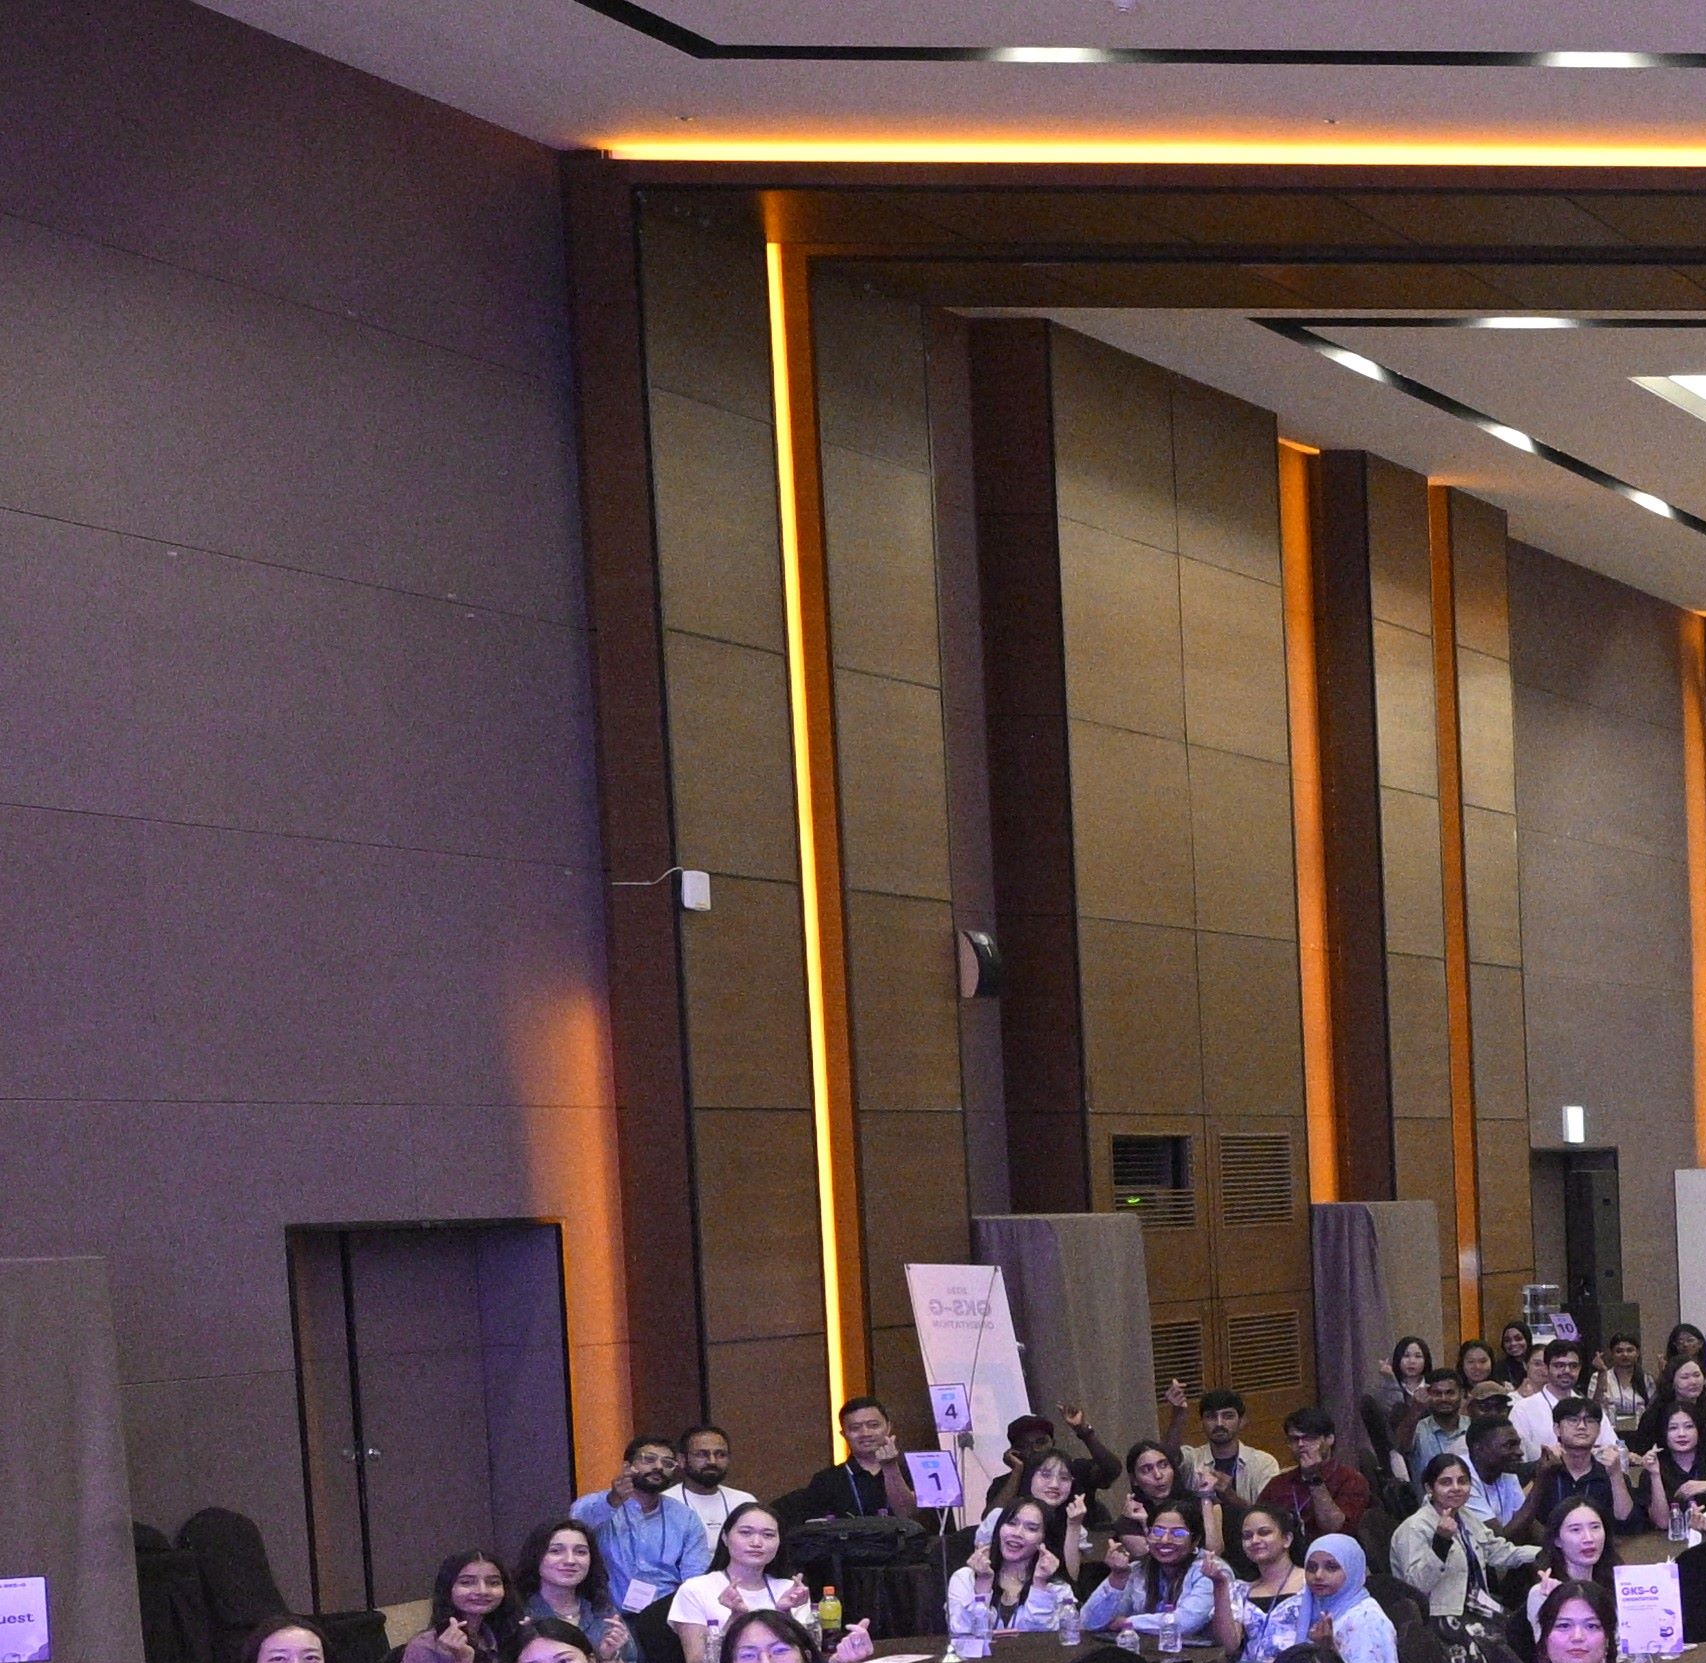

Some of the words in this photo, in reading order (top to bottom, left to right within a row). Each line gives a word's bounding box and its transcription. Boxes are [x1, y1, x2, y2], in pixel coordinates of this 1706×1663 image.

[1558, 1322, 1574, 1335] 10
[945, 1404, 957, 1419] 4
[928, 1473, 942, 1491] 1
[1621, 1586, 1659, 1596] GKS-G
[0, 1613, 35, 1624] uest
